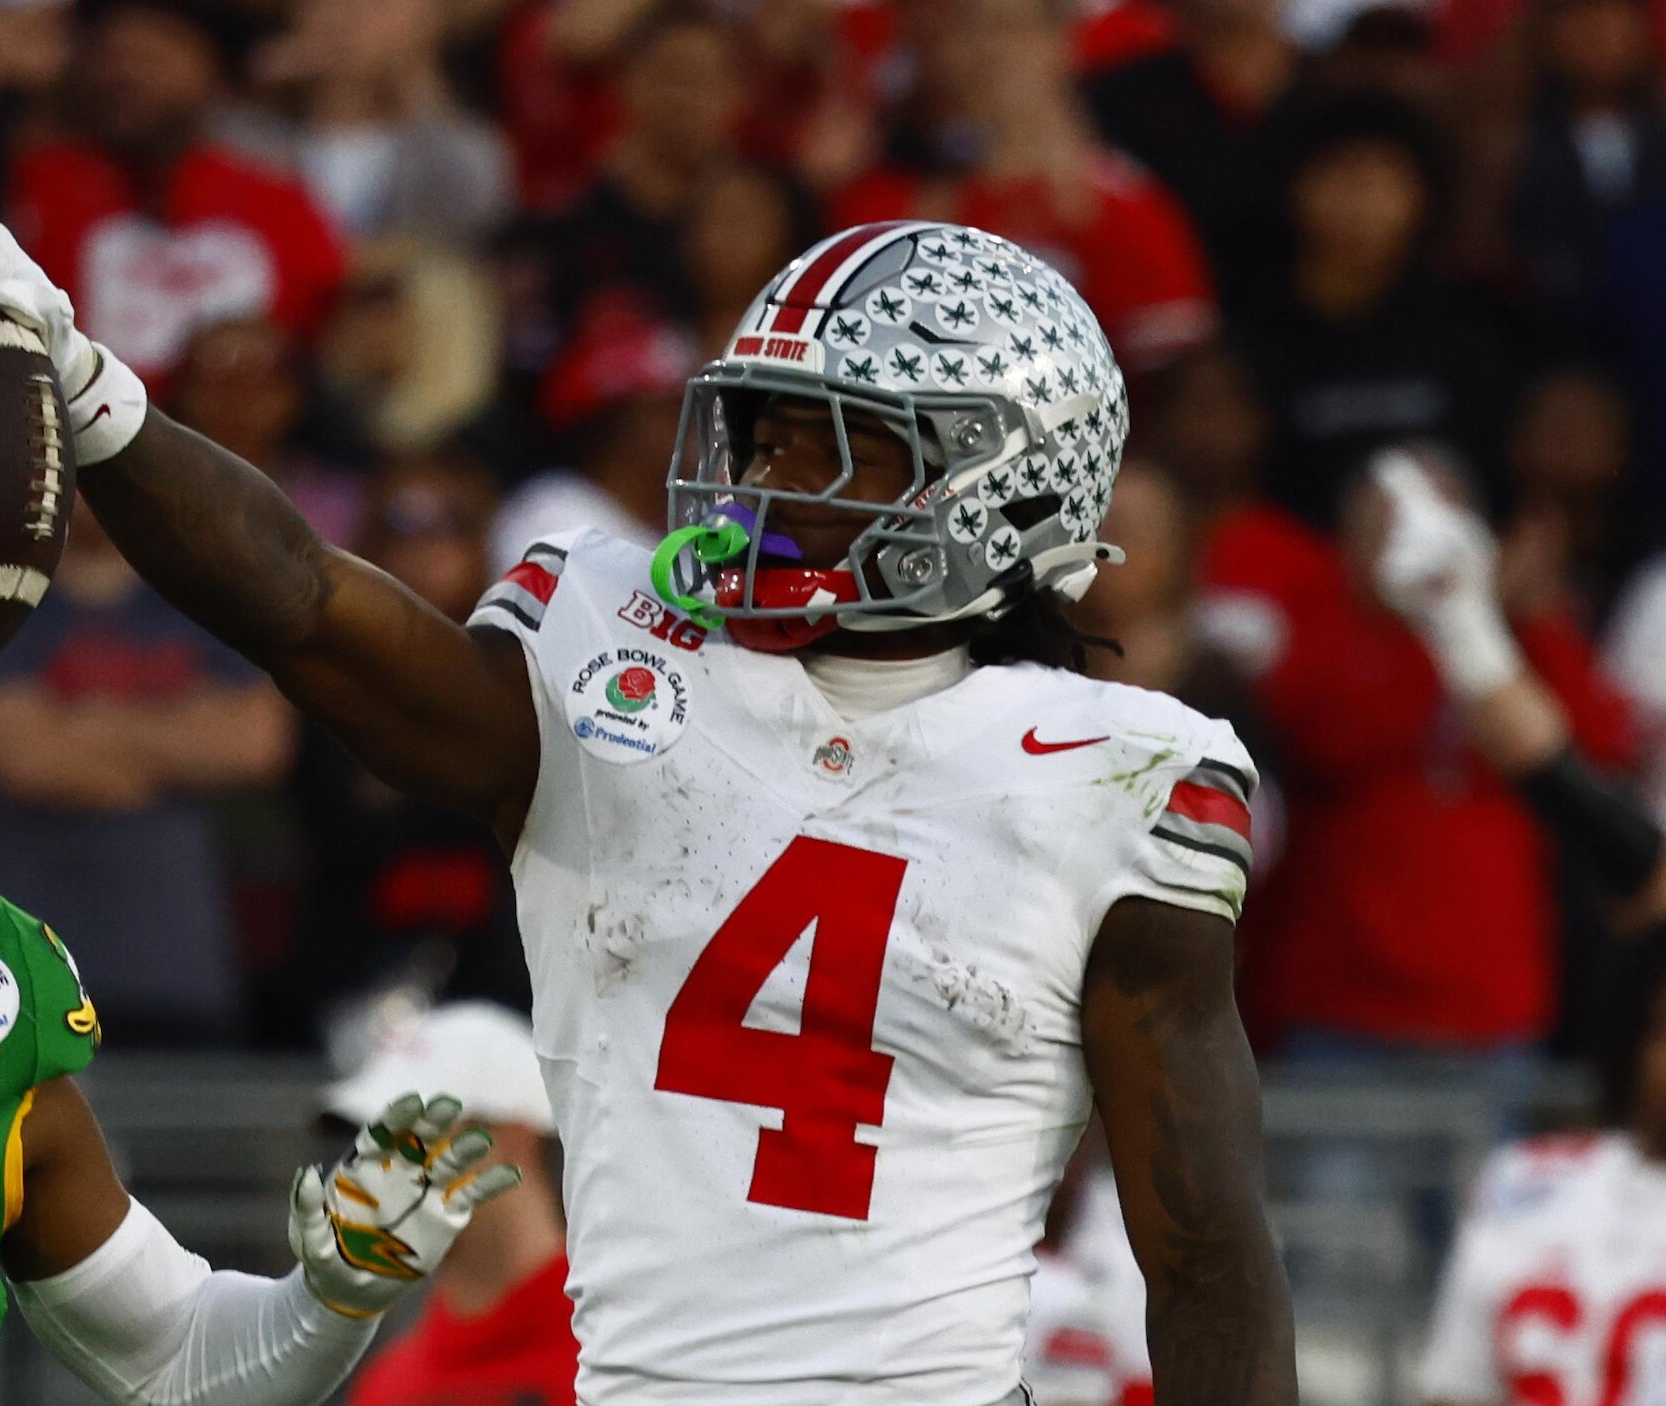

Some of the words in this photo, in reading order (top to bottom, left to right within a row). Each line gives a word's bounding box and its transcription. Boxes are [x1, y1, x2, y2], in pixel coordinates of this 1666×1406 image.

[572, 652, 613, 694] ROSE
[617, 648, 667, 676] BOWL
[667, 672, 688, 725] GAME
[594, 726, 657, 754] Prudential
[654, 834, 909, 1221] 4
